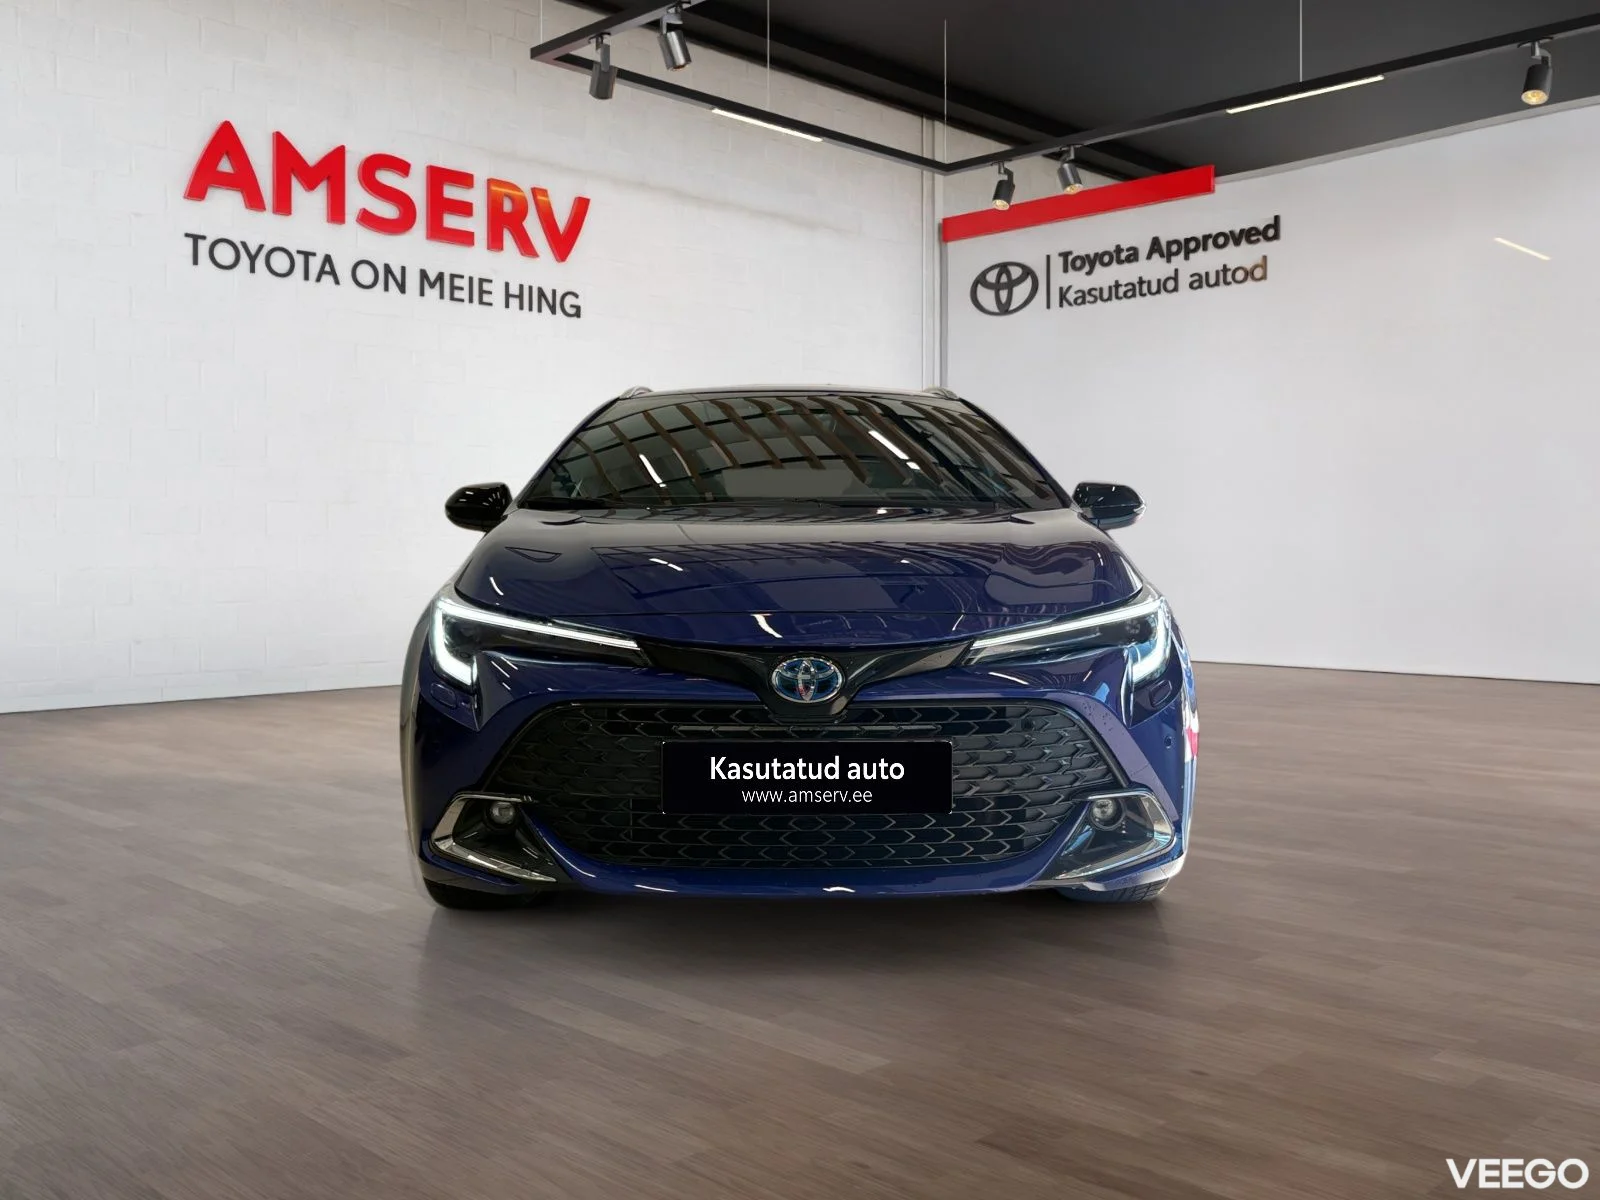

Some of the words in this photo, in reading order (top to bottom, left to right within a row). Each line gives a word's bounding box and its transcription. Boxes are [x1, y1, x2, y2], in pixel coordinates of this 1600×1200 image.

[183, 119, 591, 263] AMSERV
[1058, 244, 1140, 277] Toyota
[1146, 215, 1282, 265] Approved
[183, 232, 341, 286] TOYOTA
[350, 259, 407, 295] ON
[418, 268, 494, 307] MEIE
[503, 281, 582, 319] HING
[1058, 268, 1180, 309] Kasutatud
[1188, 255, 1269, 291] autod
[709, 755, 840, 780] Kasutatud
[847, 758, 905, 780] auto
[741, 789, 873, 803] www.amserv.ee
